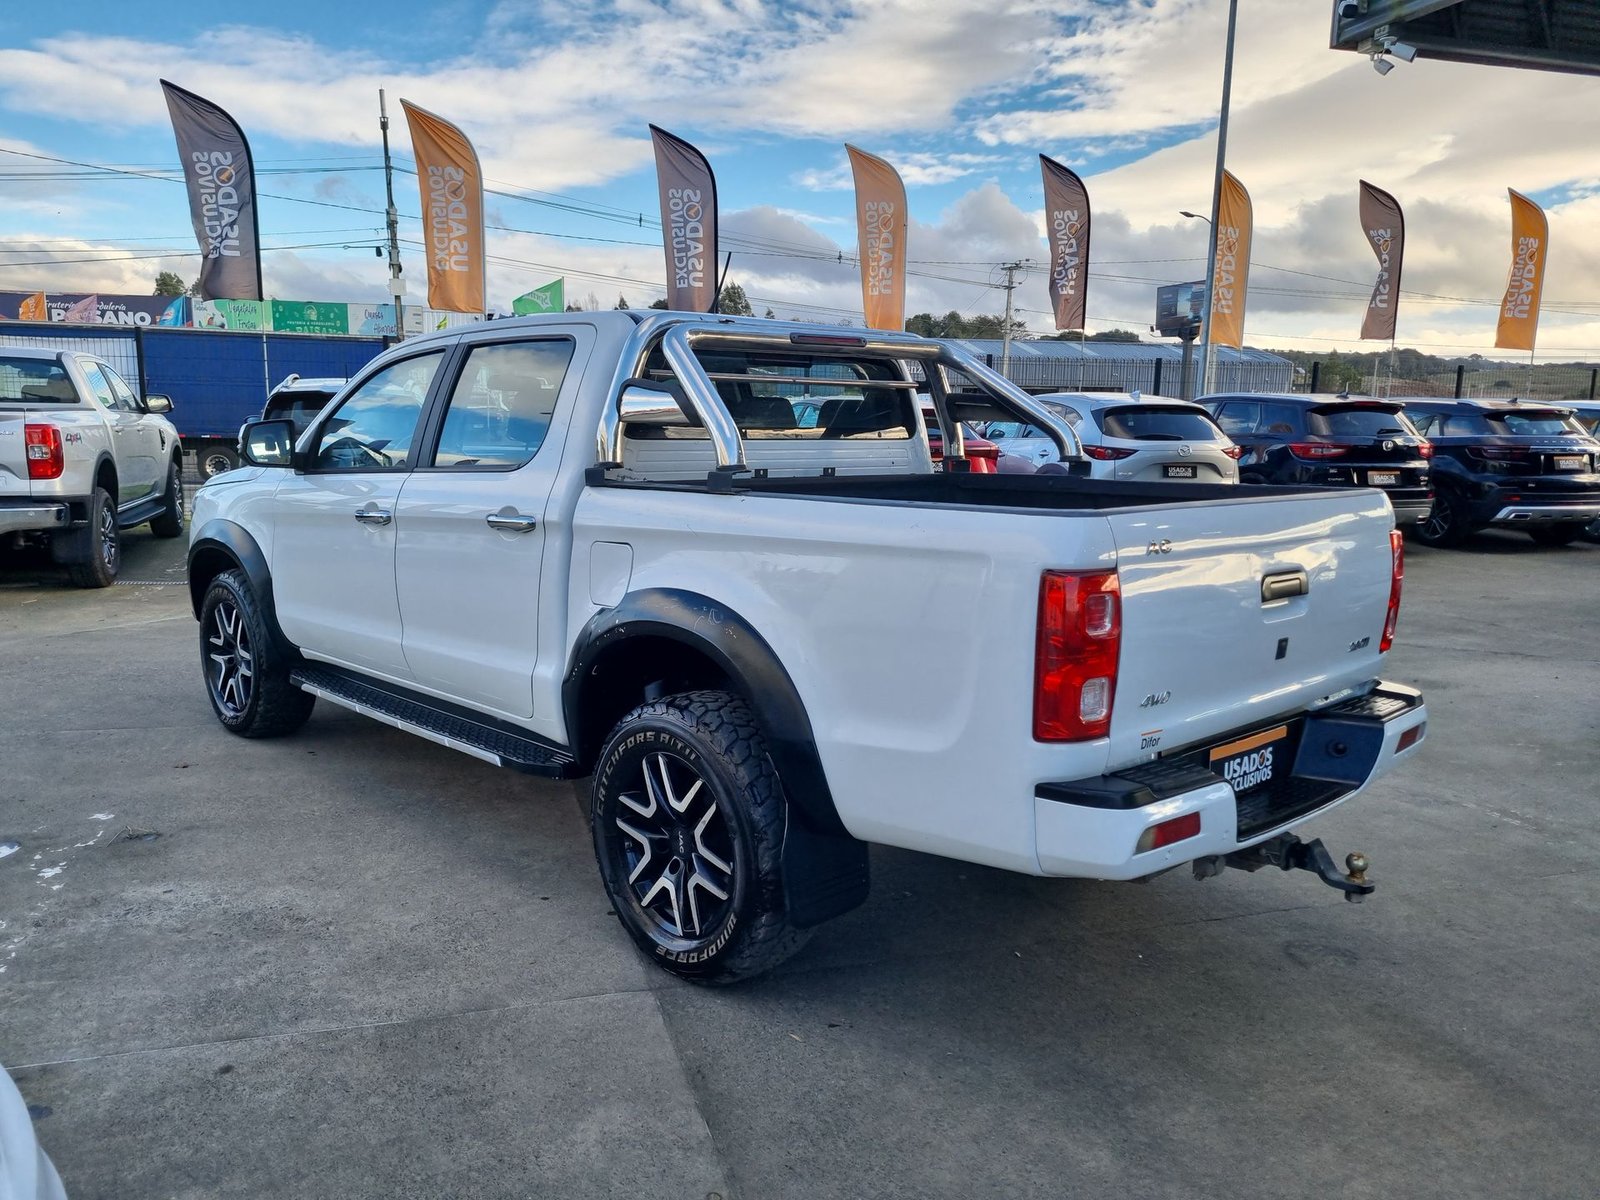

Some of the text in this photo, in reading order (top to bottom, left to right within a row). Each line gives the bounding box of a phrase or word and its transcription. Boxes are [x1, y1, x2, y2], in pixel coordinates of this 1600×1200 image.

[52, 310, 151, 326] PSANO
[296, 326, 344, 335] PAISA
[1140, 691, 1171, 708] 4WD
[1140, 736, 1161, 750] Difor
[1224, 746, 1273, 780] USADOS
[1231, 765, 1273, 791] CLUSIVOS
